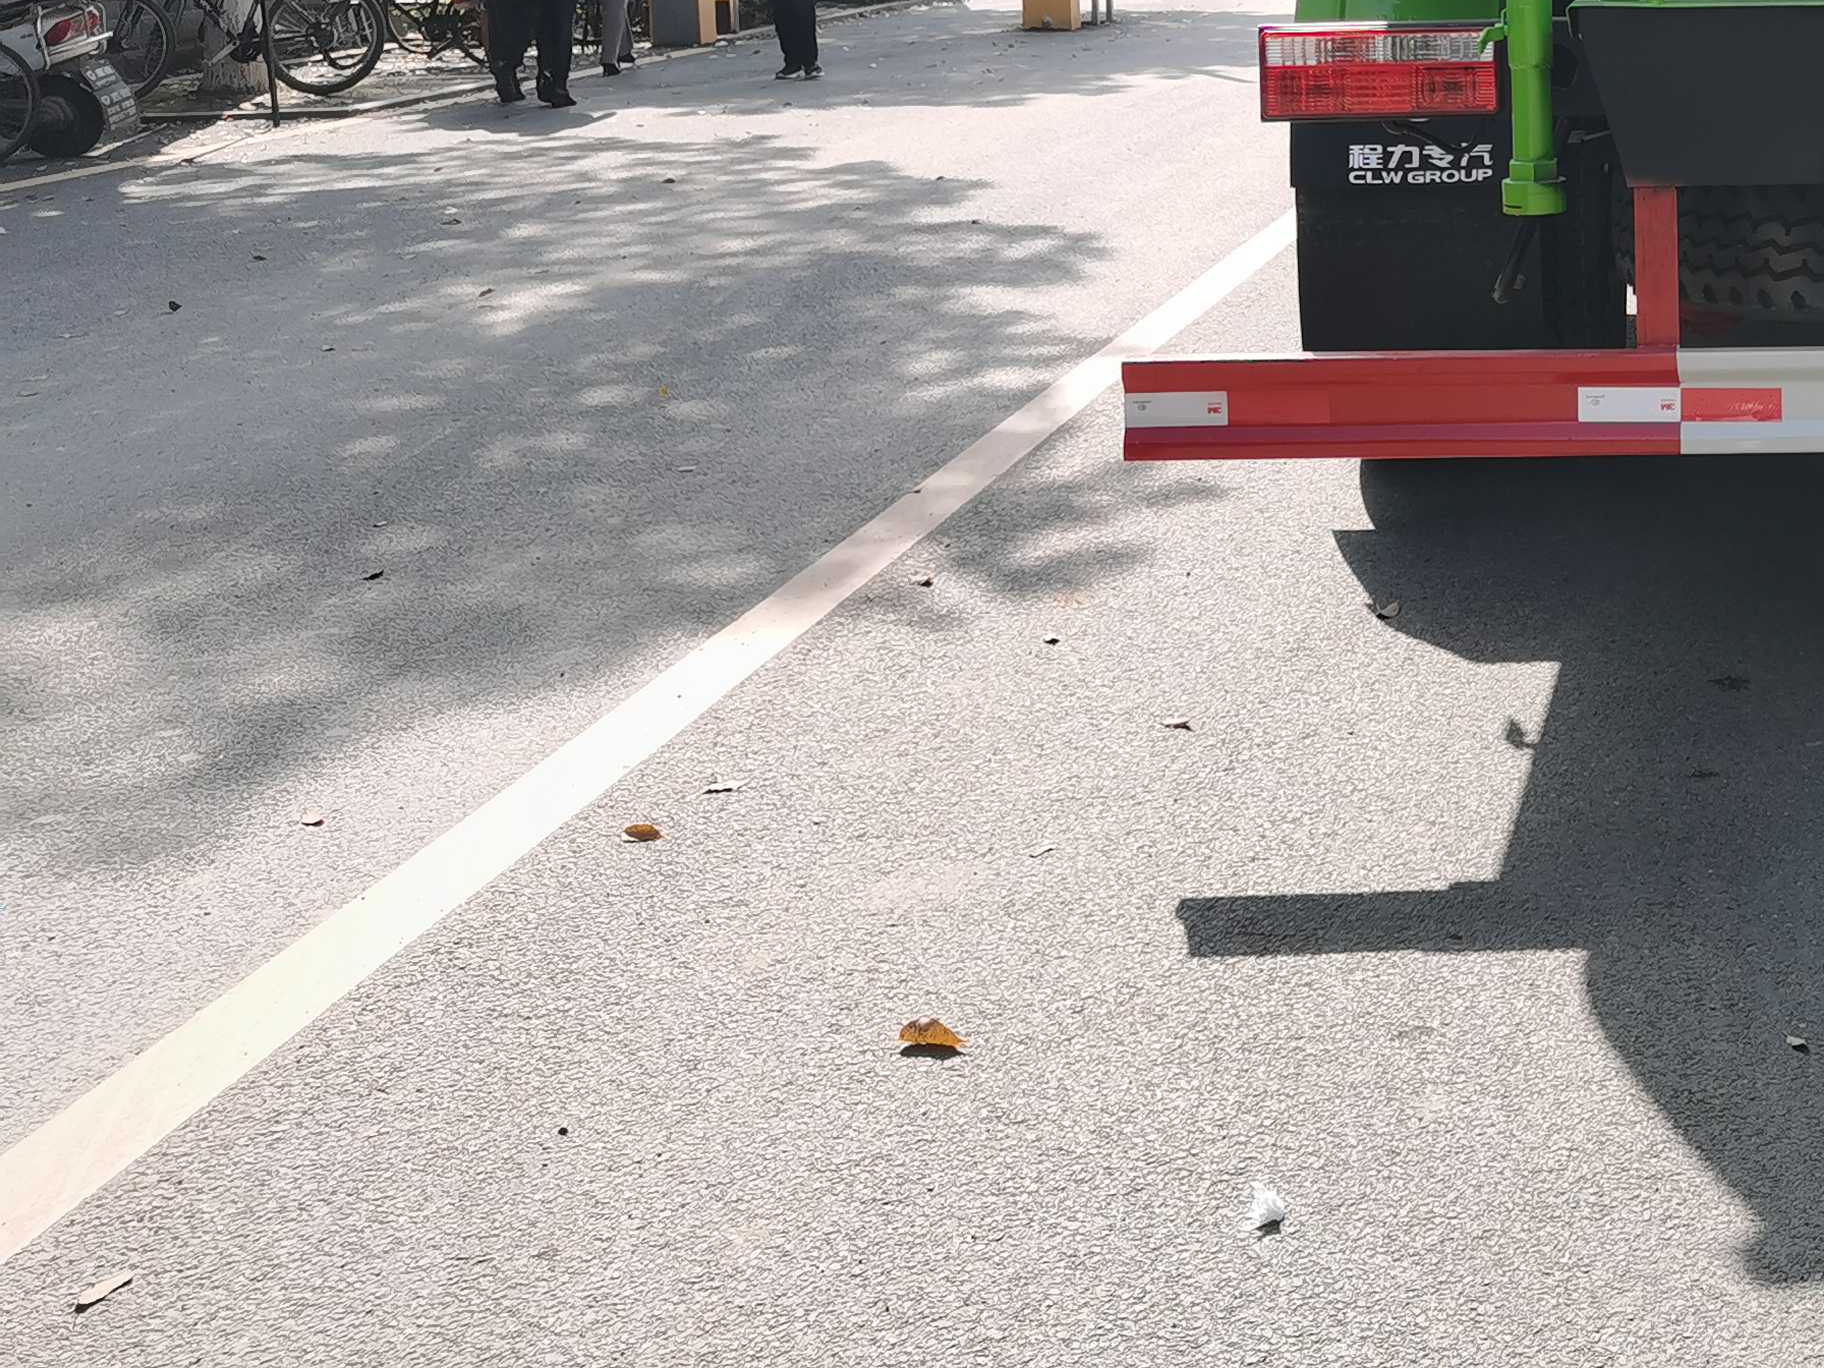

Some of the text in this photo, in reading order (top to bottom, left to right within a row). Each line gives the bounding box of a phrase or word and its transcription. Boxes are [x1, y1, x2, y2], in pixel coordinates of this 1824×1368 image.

[1348, 144, 1493, 169] 程力专汽
[1349, 169, 1493, 184] CLW GROUP
